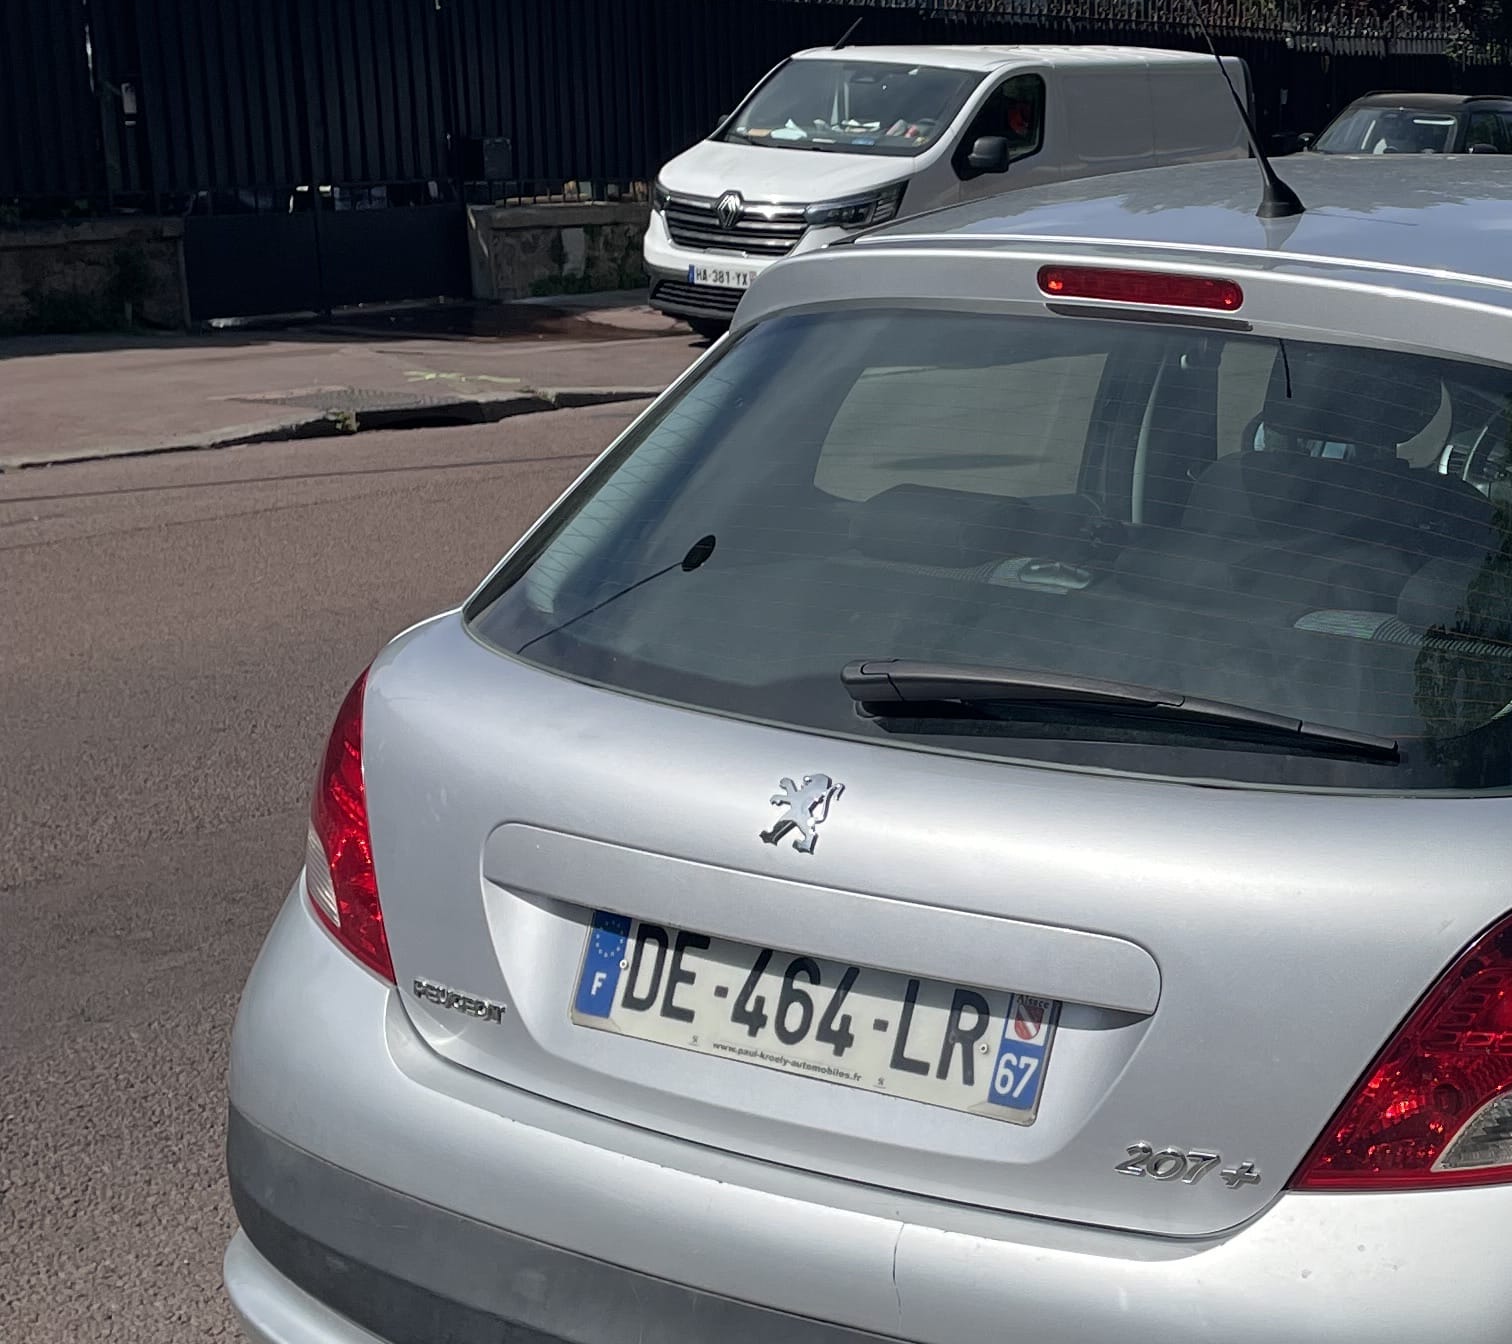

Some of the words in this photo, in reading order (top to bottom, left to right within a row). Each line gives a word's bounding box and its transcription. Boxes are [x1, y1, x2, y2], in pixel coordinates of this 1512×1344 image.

[413, 977, 507, 1025] PEUGEOT
[590, 971, 607, 995] F
[620, 922, 990, 1087] DE-464-LR
[994, 1052, 1040, 1099] 67
